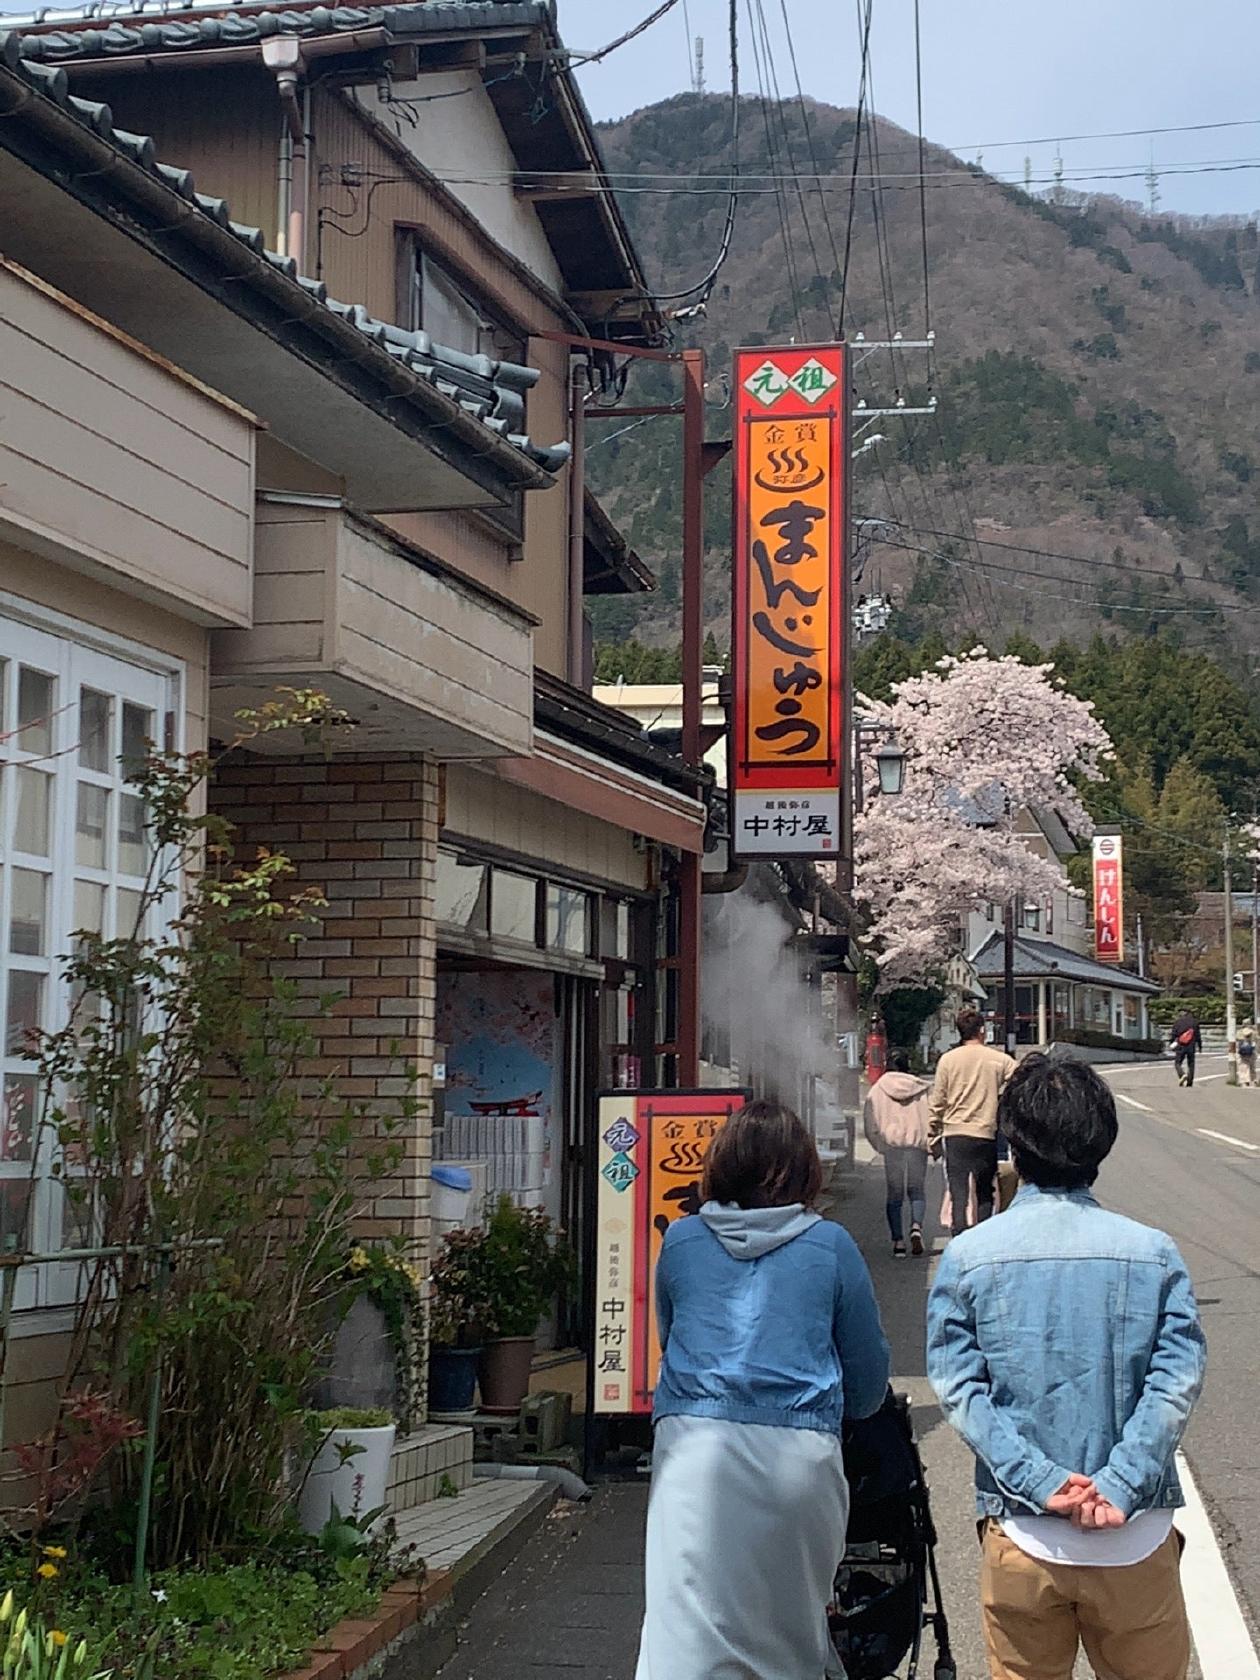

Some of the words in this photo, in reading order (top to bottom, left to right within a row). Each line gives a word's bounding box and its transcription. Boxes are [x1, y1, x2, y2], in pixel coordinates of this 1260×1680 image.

[752, 366, 826, 393] 元祖
[752, 500, 826, 755] まんじゅう
[744, 815, 832, 837] 中村屋
[1099, 868, 1118, 944] けんしん
[606, 1122, 635, 1182] 元祖
[598, 1297, 627, 1373] 中村屋
